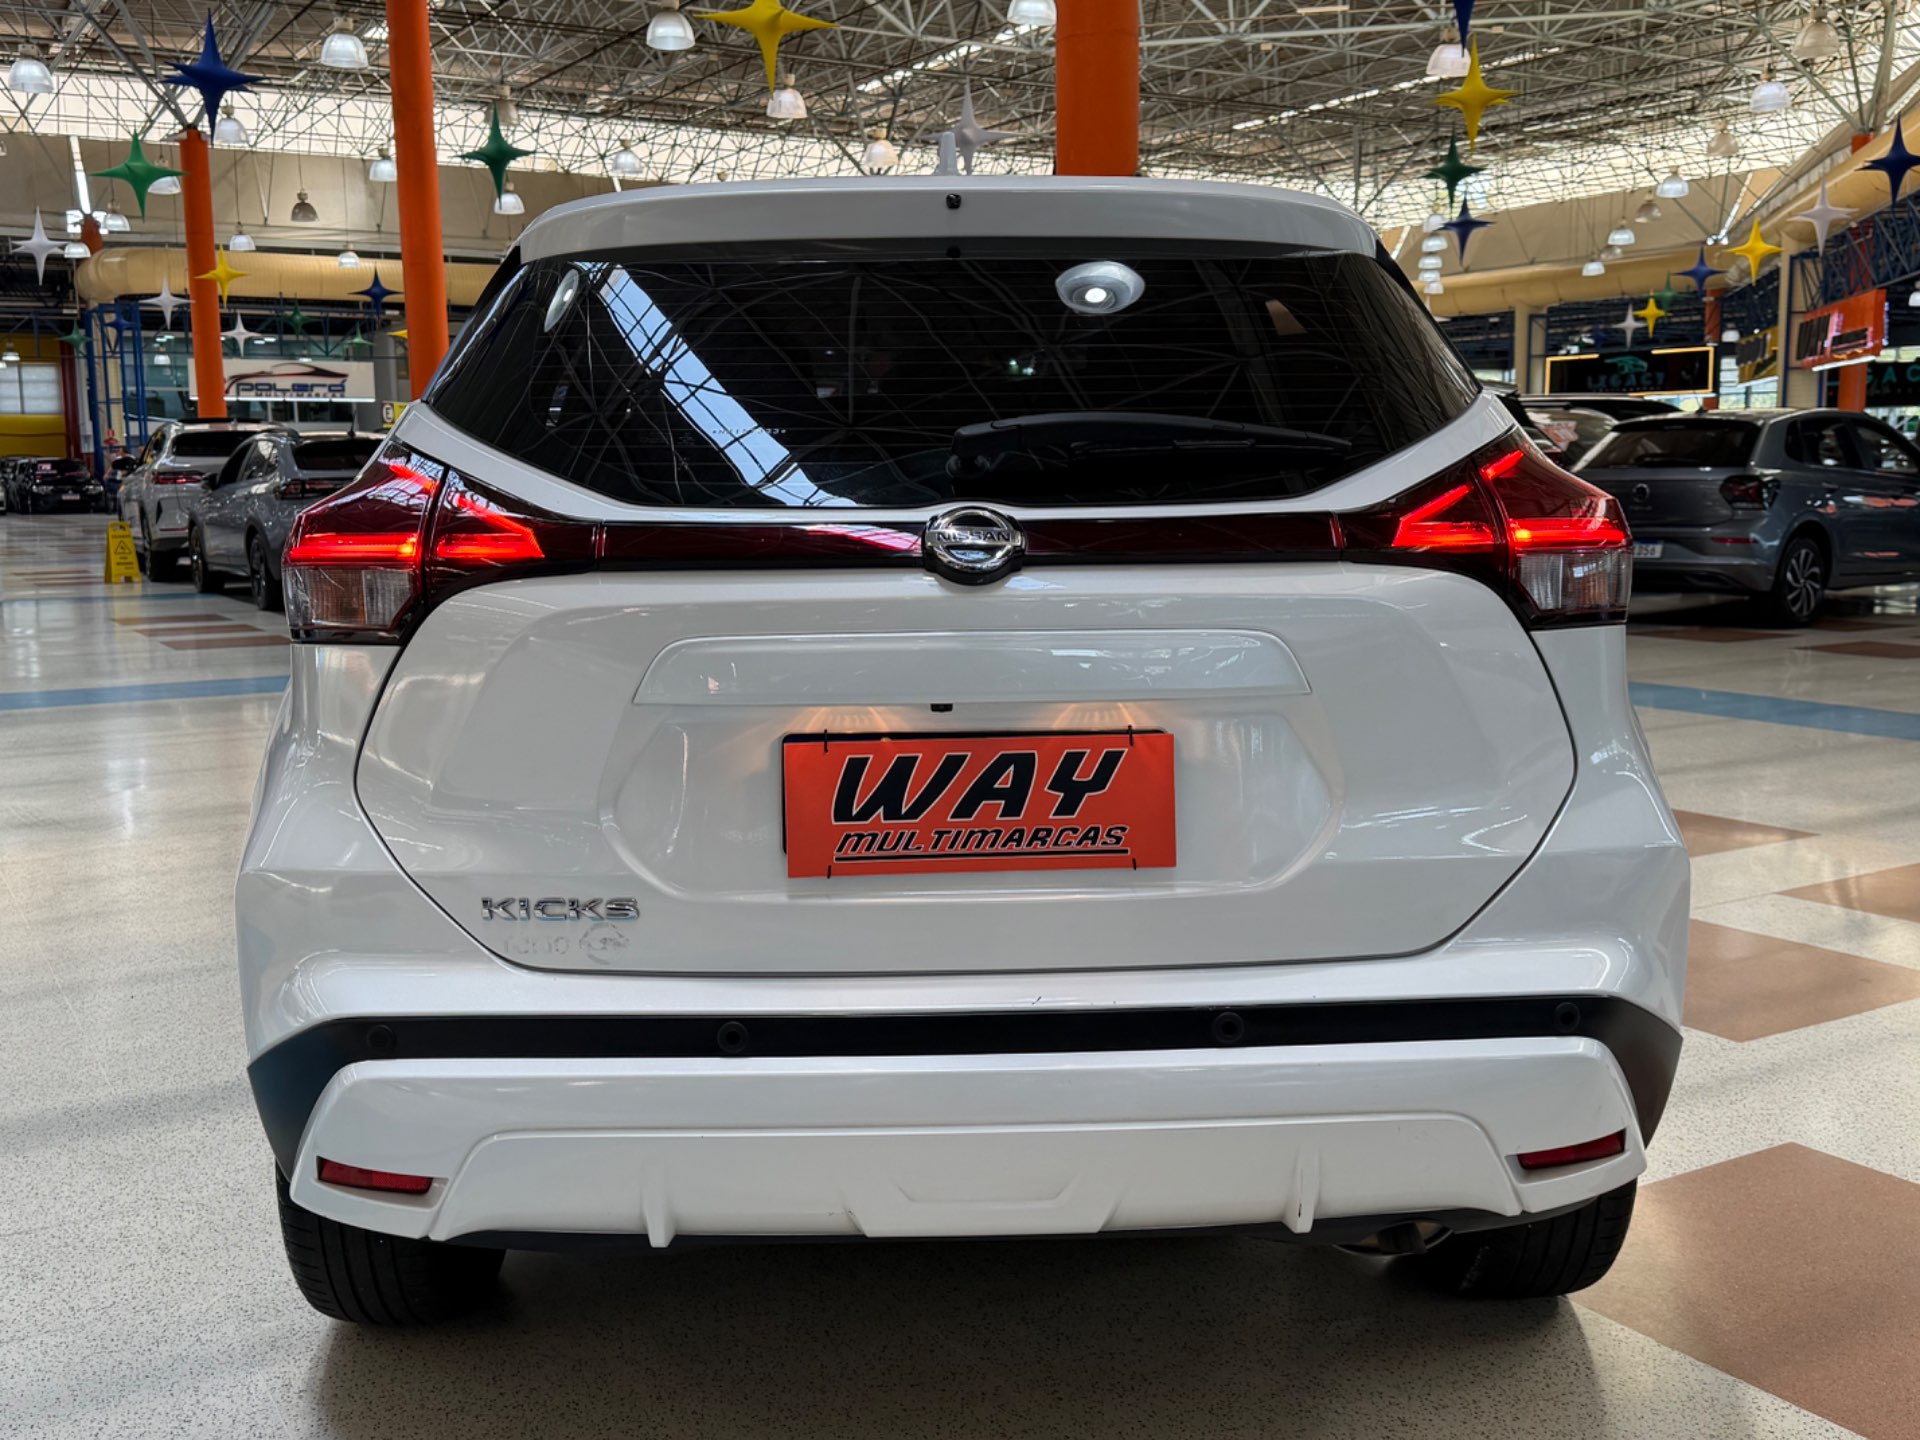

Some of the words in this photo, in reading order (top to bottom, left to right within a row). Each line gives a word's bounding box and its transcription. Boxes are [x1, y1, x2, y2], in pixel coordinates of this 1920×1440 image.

[936, 530, 1012, 542] NISSAN
[831, 748, 1129, 824] WAY
[834, 824, 1130, 854] MULTIMARCAS
[481, 897, 640, 921] KICKS
